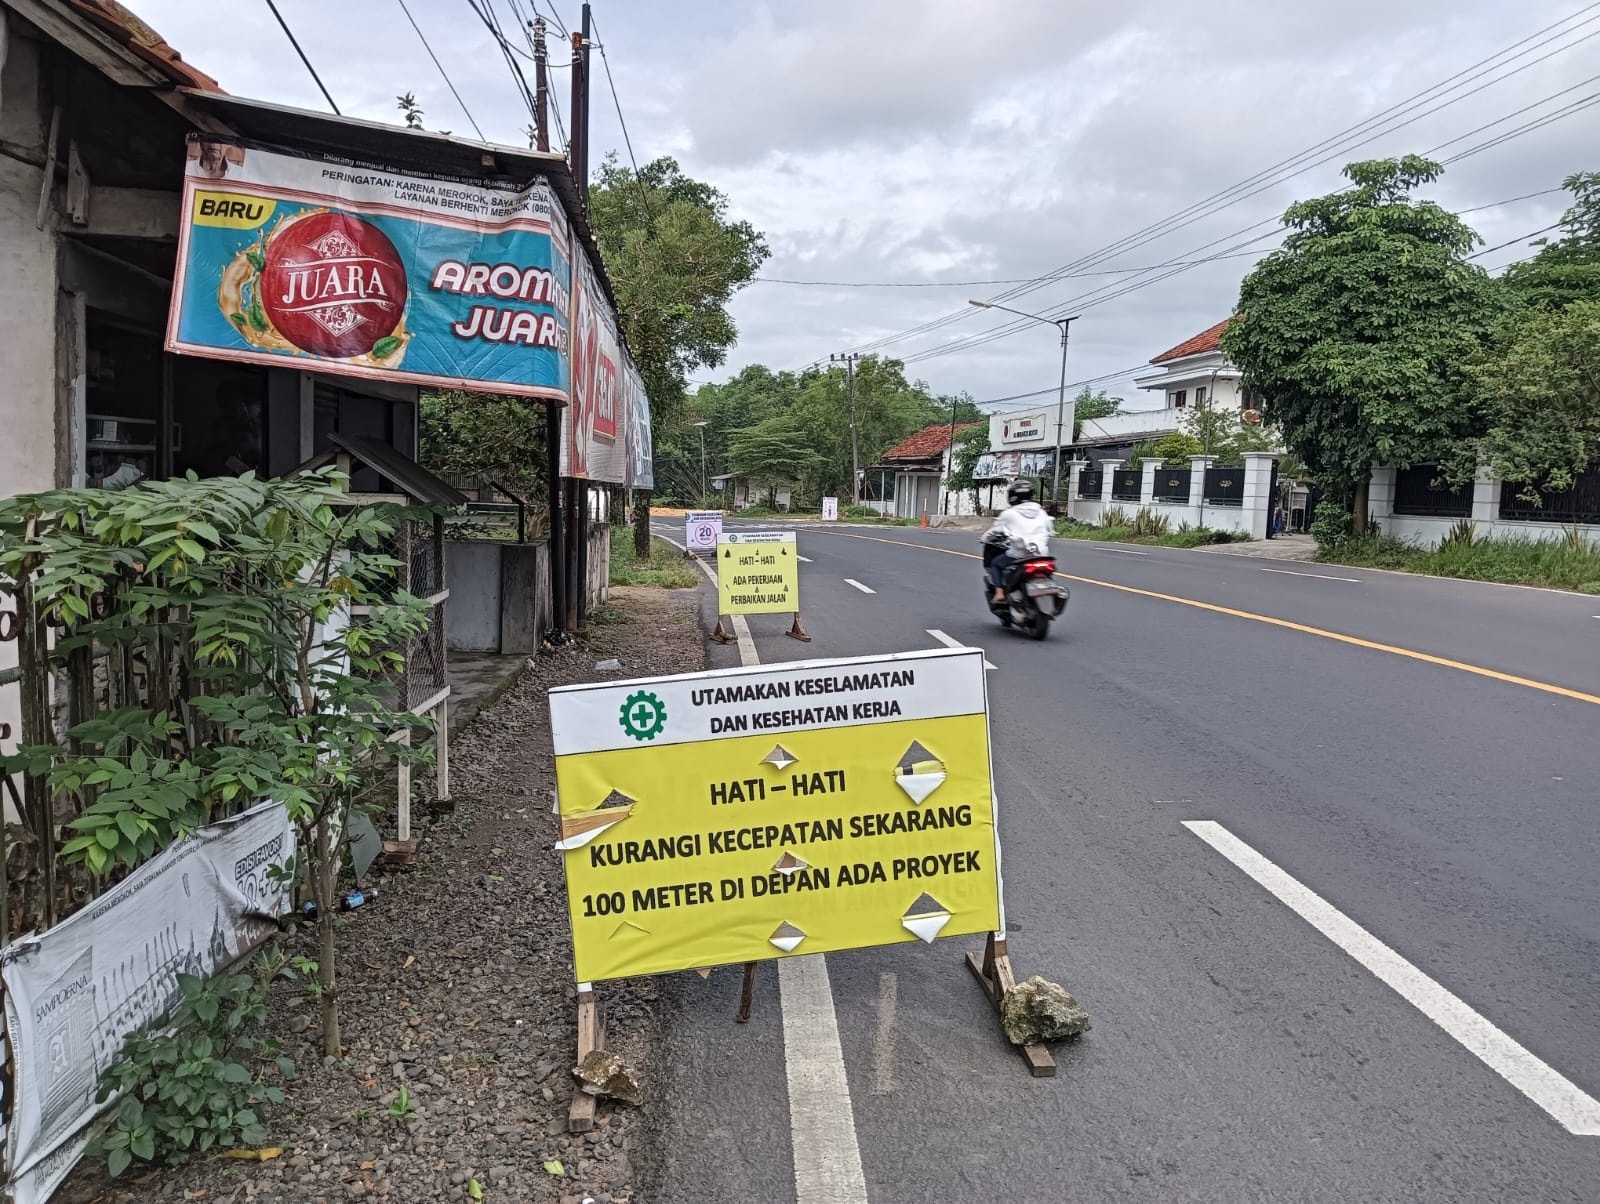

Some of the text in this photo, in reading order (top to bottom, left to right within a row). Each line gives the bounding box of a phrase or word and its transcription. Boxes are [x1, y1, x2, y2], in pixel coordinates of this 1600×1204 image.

[321, 169, 395, 188] PERINGATAN:
[396, 180, 436, 194] KARENA
[438, 187, 489, 206] MEROKOK,
[491, 197, 513, 209] SAYA
[394, 189, 439, 206] LAYANAN
[440, 198, 489, 215] BERHENTI
[199, 199, 263, 219] BARU
[281, 264, 388, 304] JUARA
[699, 528, 711, 537] 20
[739, 557, 754, 565] HATI
[761, 556, 775, 565] HATI
[733, 575, 782, 585] ADA PEKERJAAN
[731, 594, 785, 604] PERBAIKAN JALAN
[691, 669, 915, 707] UTAMAKAN KESELAMATAN
[710, 699, 902, 734] DAN KESEHATAN KERJA
[710, 777, 765, 805] HATI
[792, 770, 846, 796] HATI
[589, 805, 973, 868] KURANGI KECEPATAN SEKARANG
[235, 856, 255, 881] EDISI
[581, 850, 981, 918] 100 METER DI DEPAN ADA PROYEK
[36, 975, 88, 1024] SAMPOERNA
